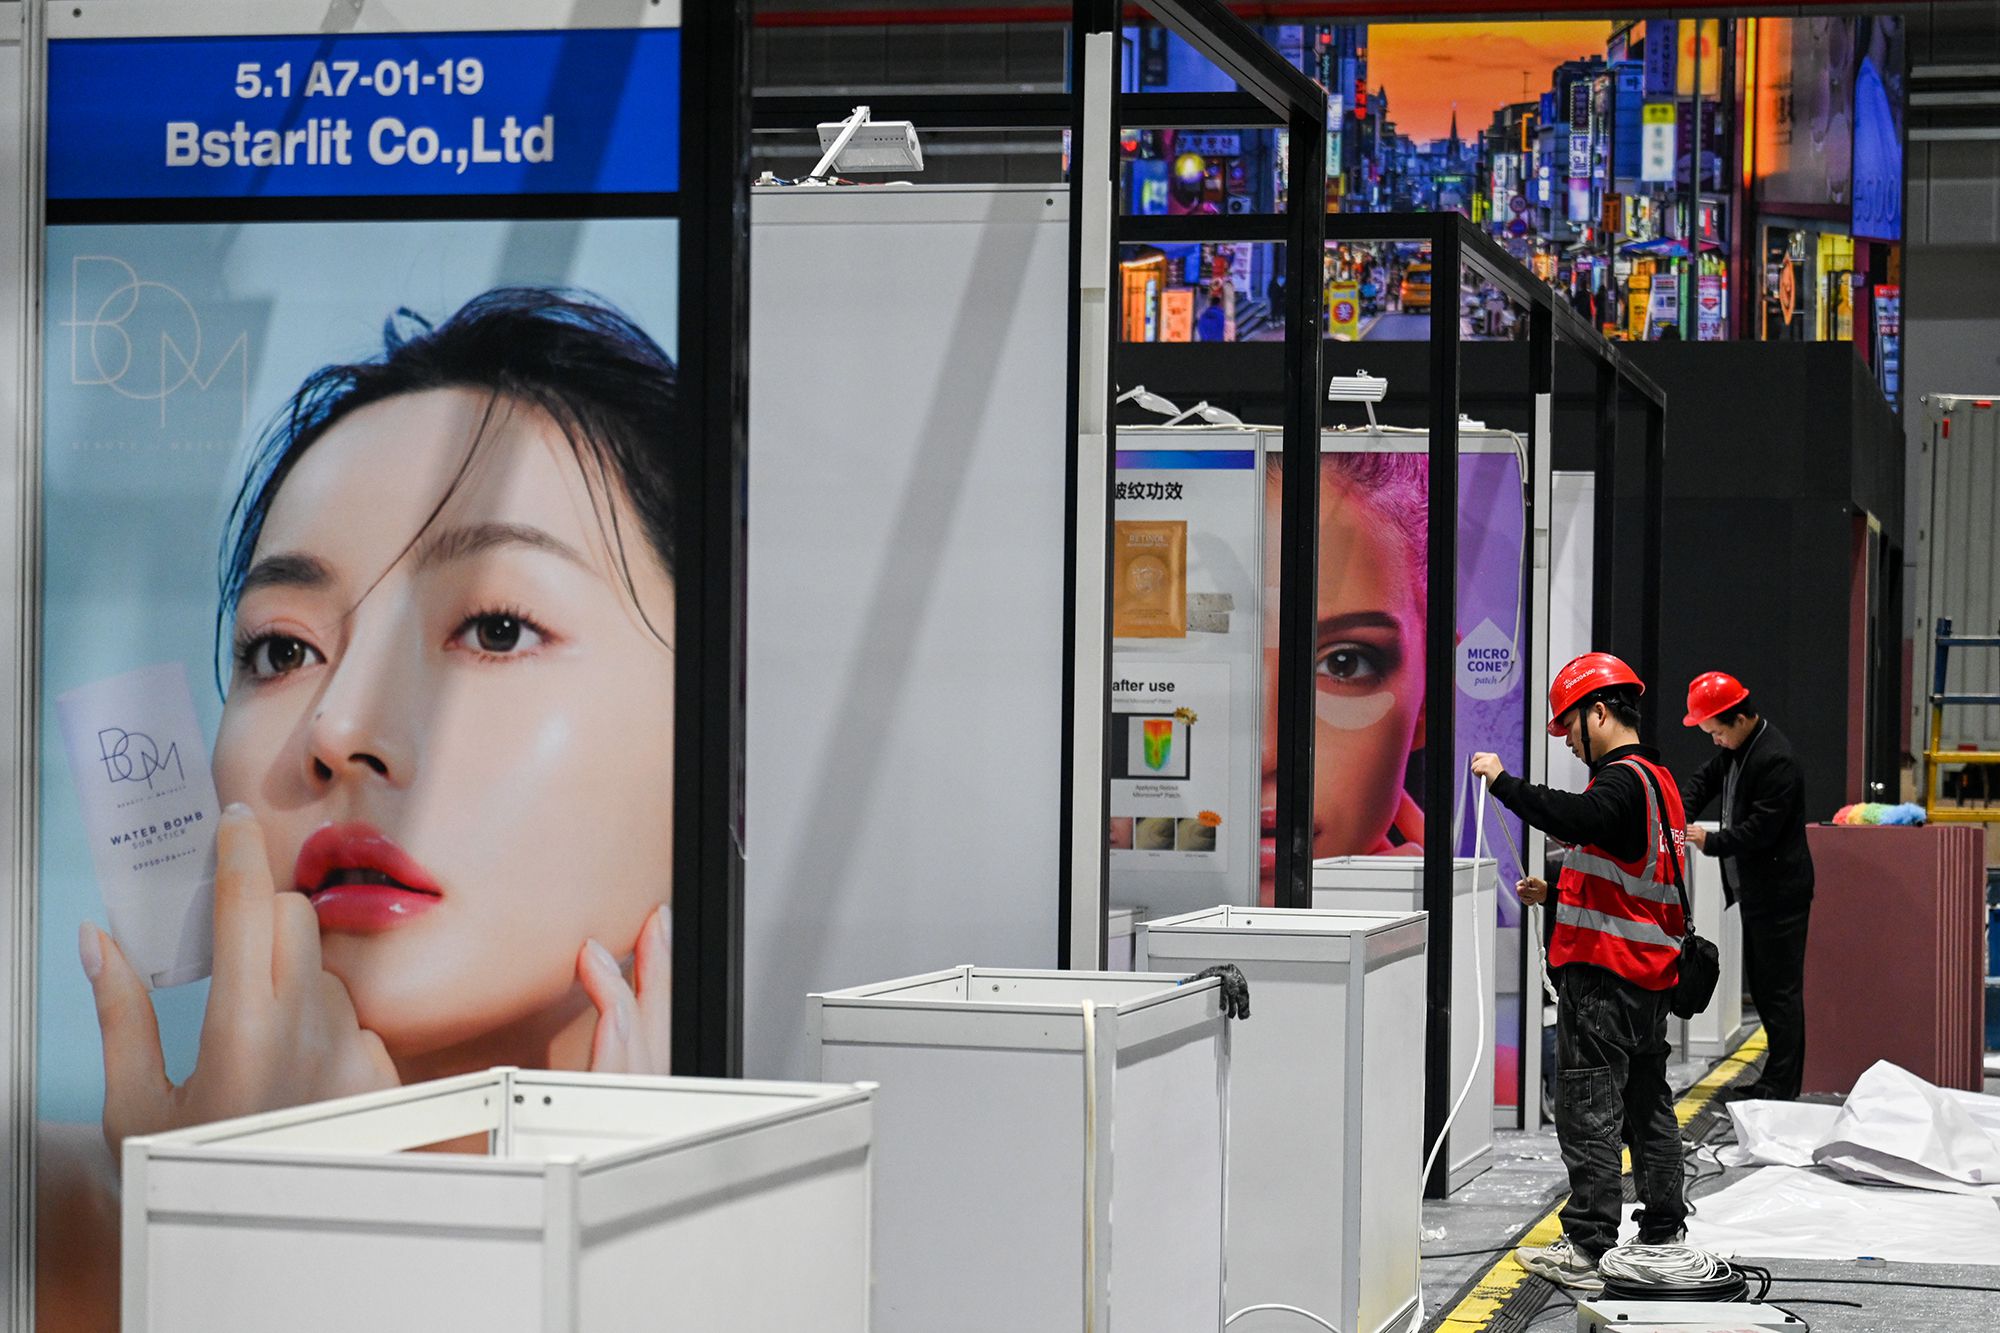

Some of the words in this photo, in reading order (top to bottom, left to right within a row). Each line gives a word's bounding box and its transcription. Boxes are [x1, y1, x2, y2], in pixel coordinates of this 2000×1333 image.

[234, 62, 291, 99] 5.1
[304, 58, 485, 97] A7-01-19
[165, 118, 352, 167] Bstarlit
[367, 114, 554, 175] Co.,Ltd
[1467, 648, 1510, 660] MICRO
[1112, 679, 1144, 692] after
[1149, 681, 1176, 692] use
[1474, 675, 1497, 687] patch
[110, 825, 157, 846] WATER
[163, 811, 204, 831] BOMB
[157, 828, 186, 842] STICK
